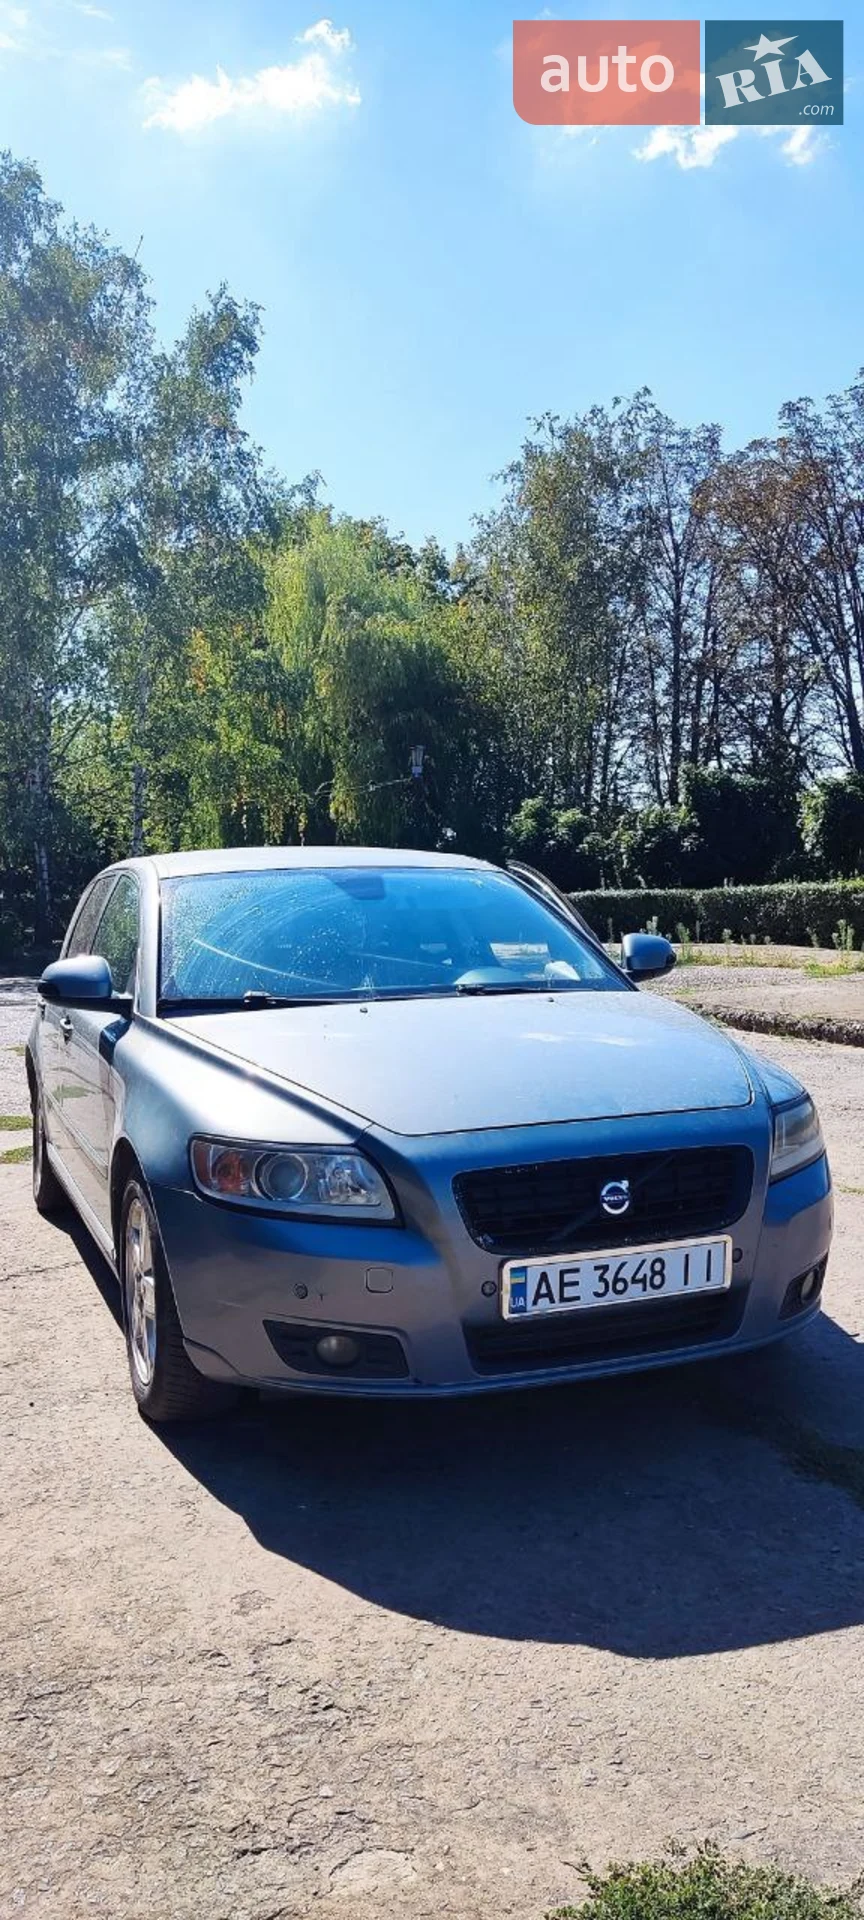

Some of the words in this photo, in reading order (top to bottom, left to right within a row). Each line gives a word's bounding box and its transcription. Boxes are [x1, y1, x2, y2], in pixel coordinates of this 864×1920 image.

[532, 1267, 580, 1306] AE
[592, 1257, 666, 1298] 3648
[510, 1297, 526, 1308] UA
